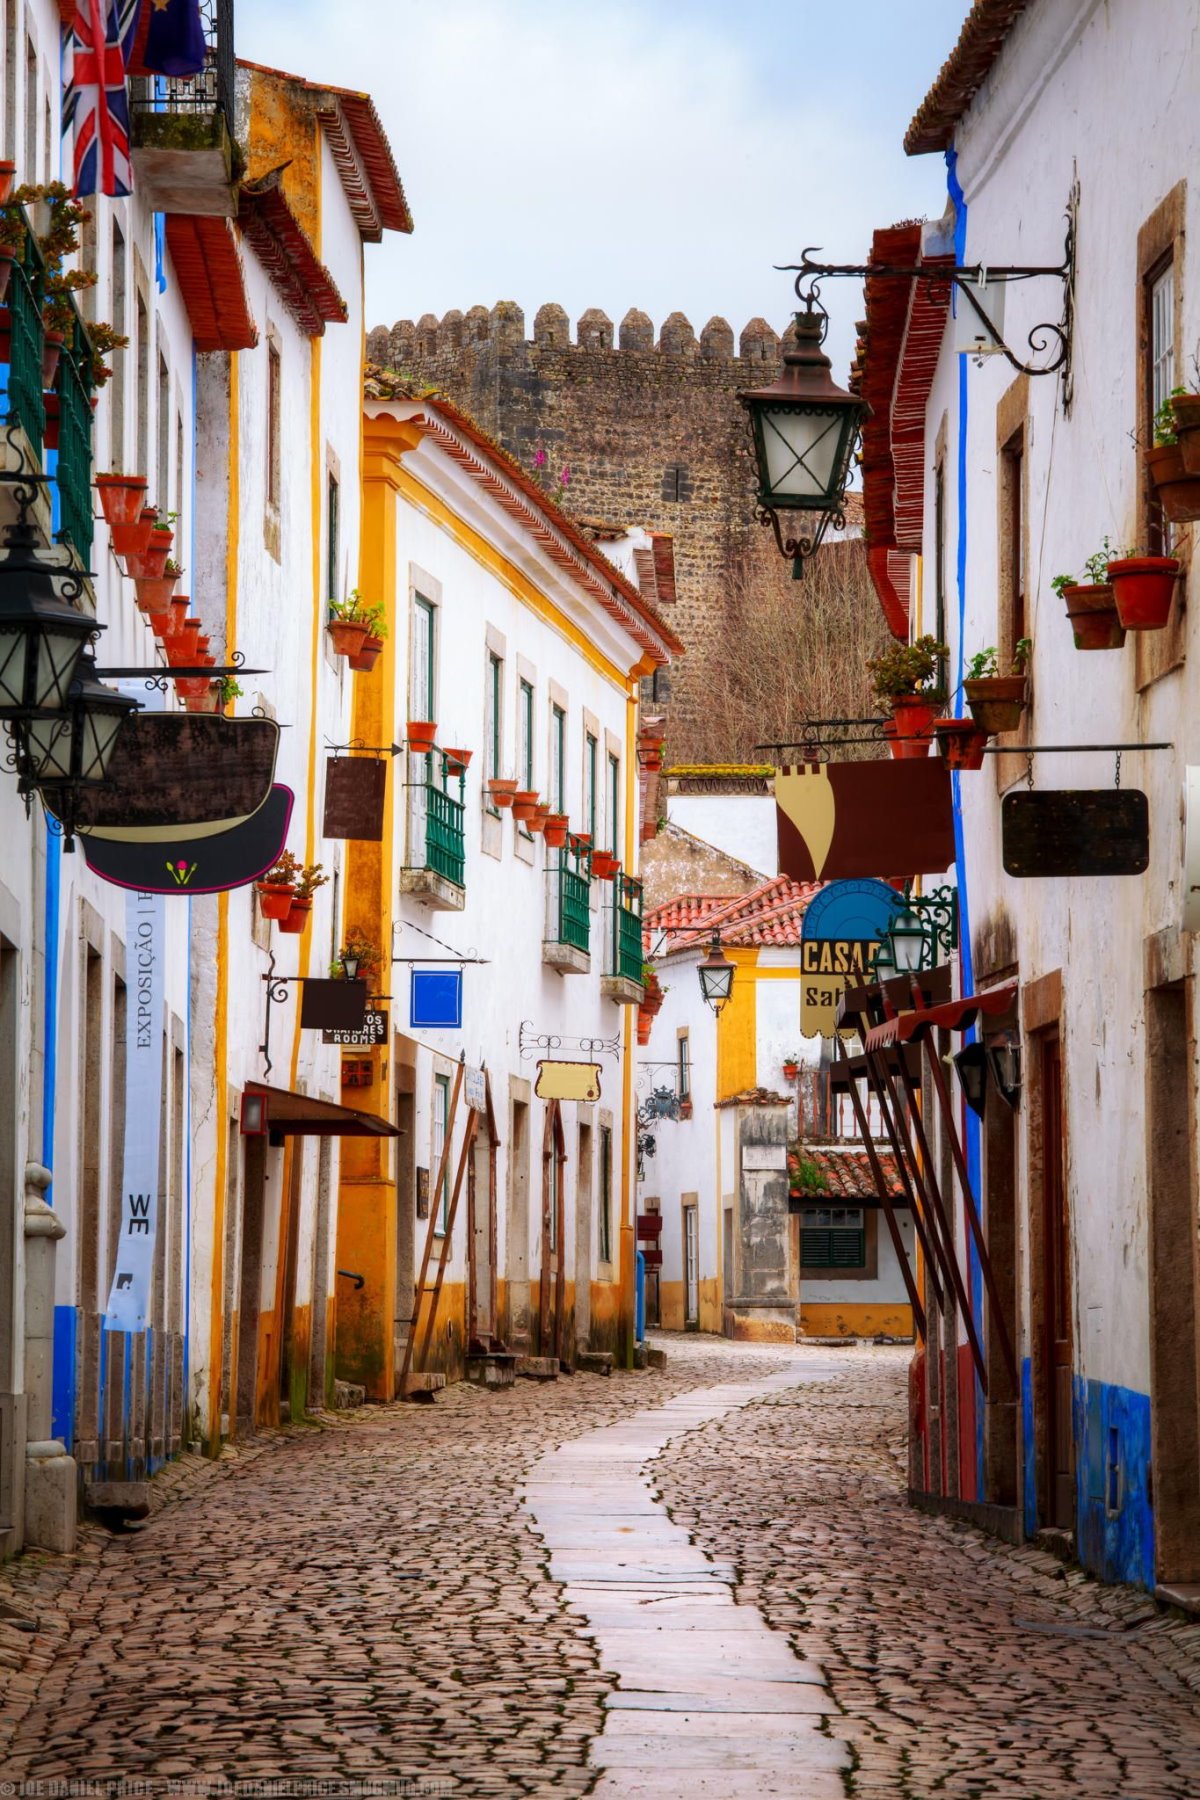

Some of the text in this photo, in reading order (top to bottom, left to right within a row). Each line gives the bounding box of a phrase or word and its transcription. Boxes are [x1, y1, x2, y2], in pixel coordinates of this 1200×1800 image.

[803, 942, 864, 973] CASA
[134, 922, 156, 1049] EXPOSIÇÃO
[334, 1034, 376, 1044] ROOMS
